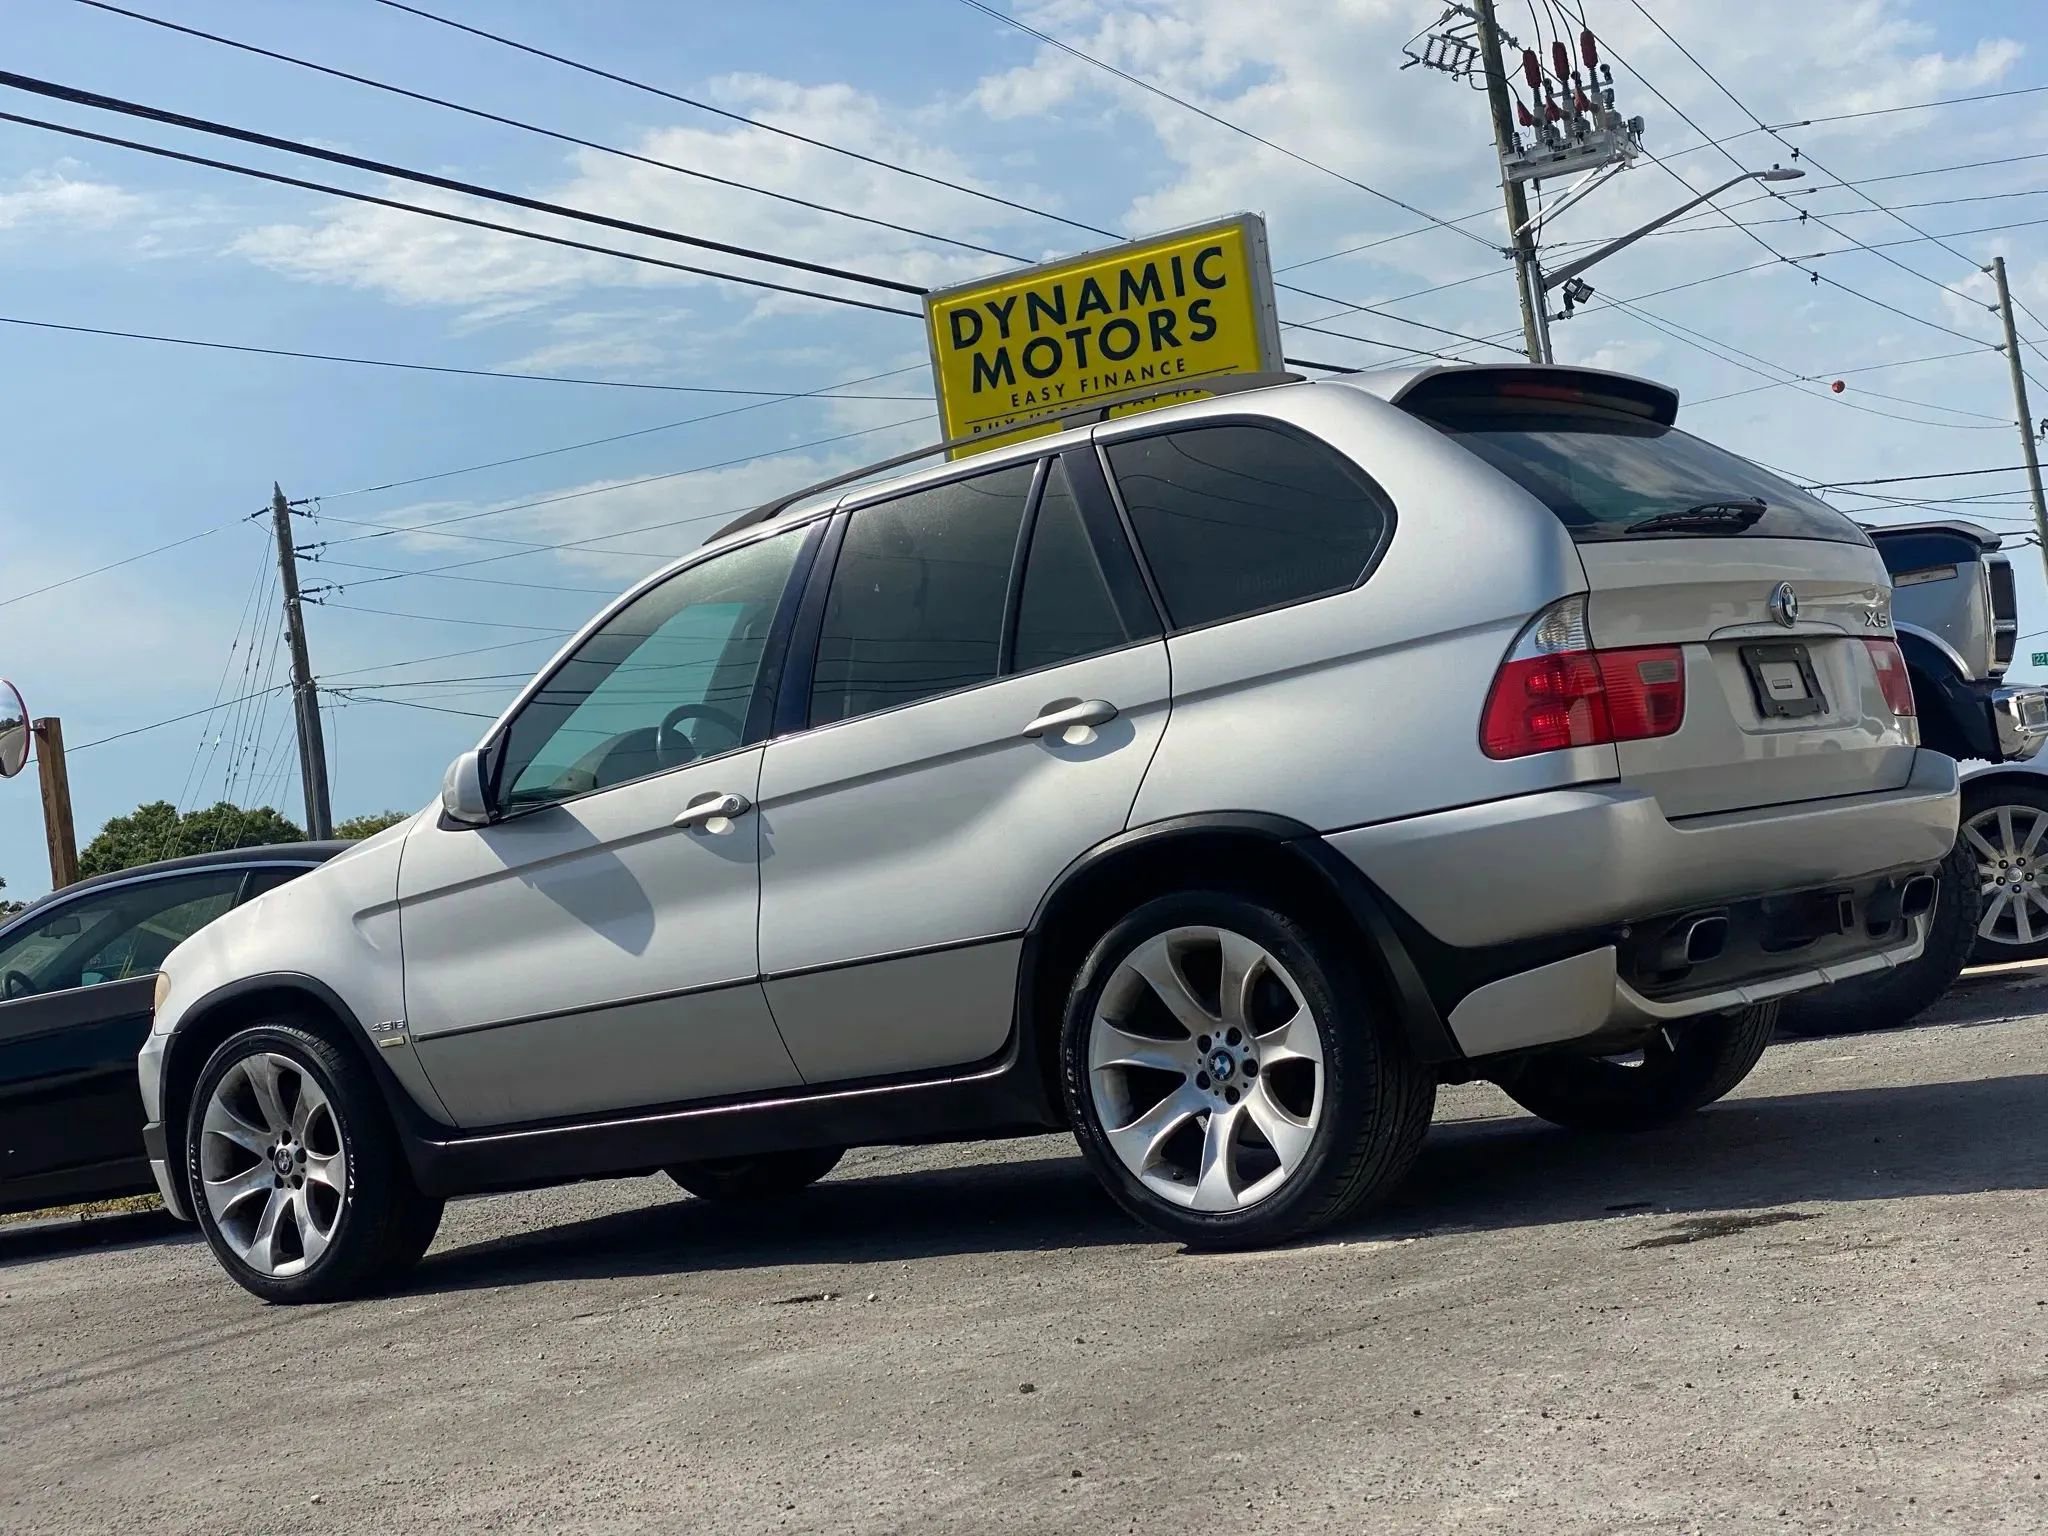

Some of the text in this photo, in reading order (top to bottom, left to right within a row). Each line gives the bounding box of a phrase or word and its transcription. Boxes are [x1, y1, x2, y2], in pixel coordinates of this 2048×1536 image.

[950, 246, 1227, 351] DYNAMIC
[972, 298, 1218, 394] MOTORS
[1011, 383, 1066, 408] EASY
[1080, 357, 1187, 393] FINANCE
[1864, 611, 1888, 628] X5
